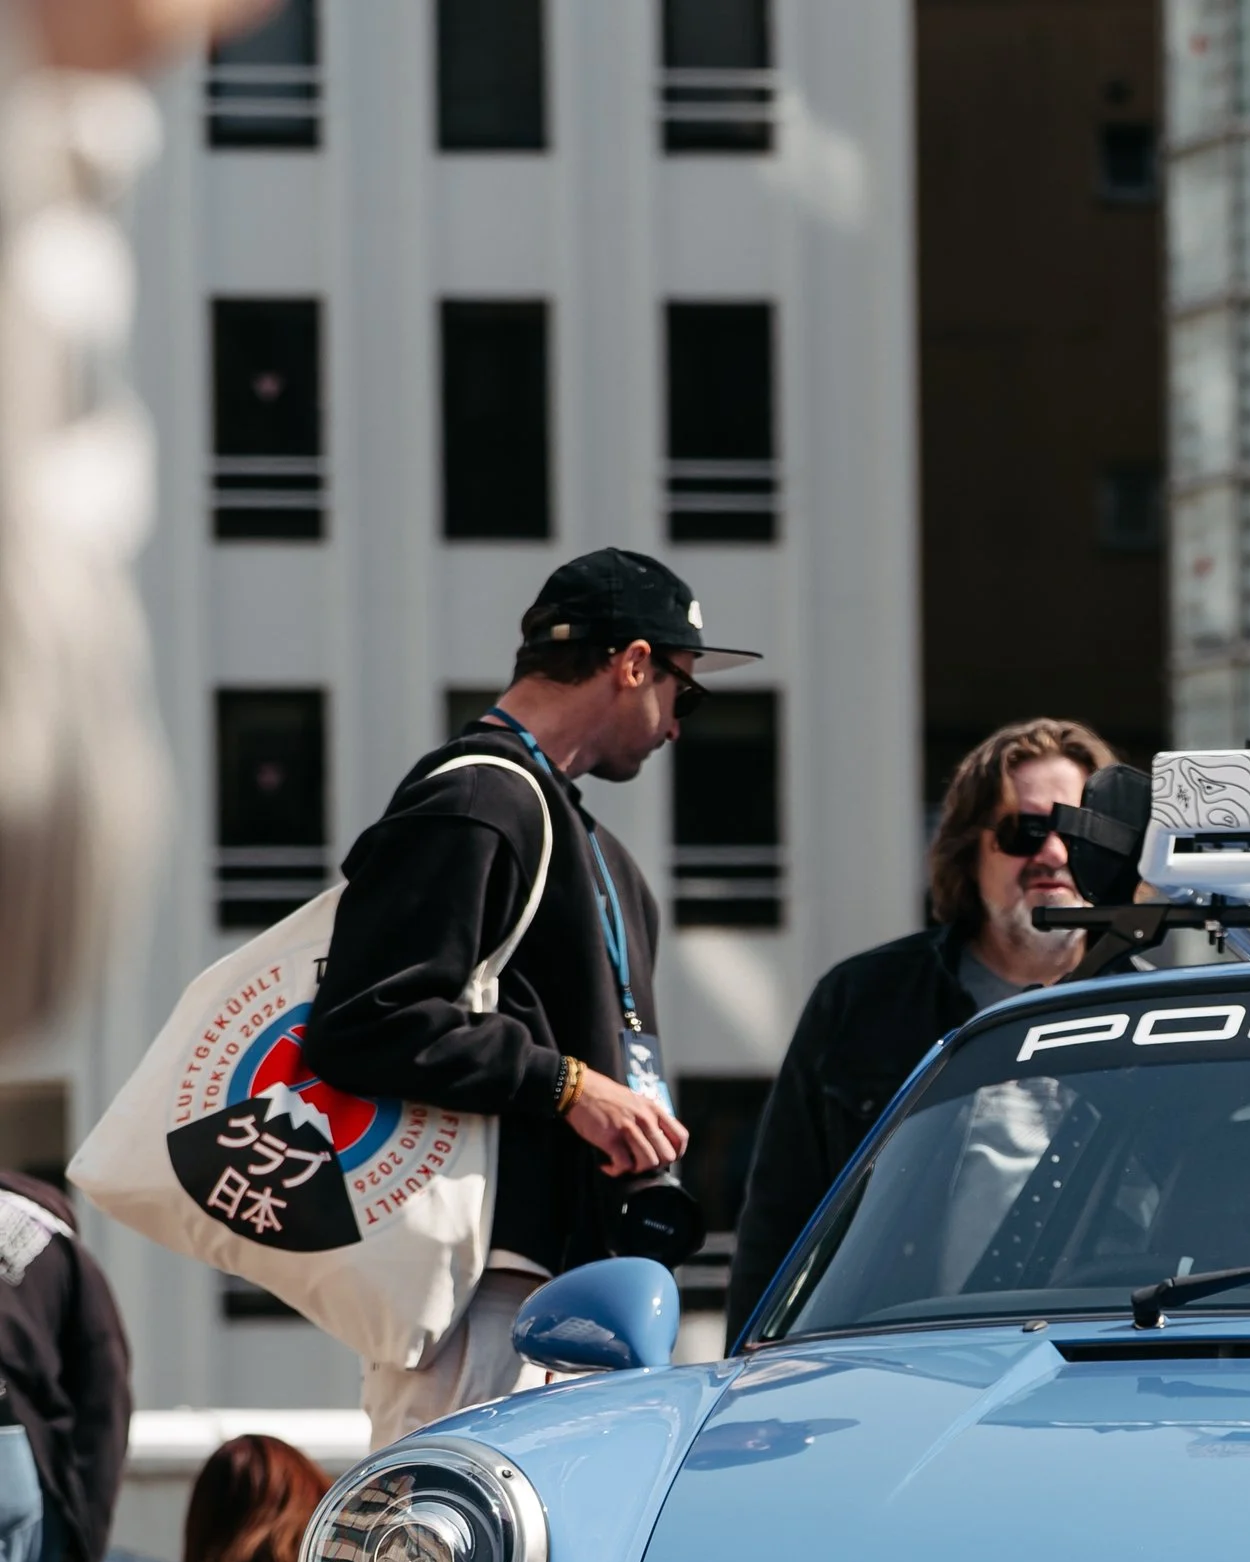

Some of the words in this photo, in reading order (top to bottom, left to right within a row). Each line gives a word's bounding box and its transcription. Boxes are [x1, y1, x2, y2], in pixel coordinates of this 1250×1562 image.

[176, 966, 283, 1124] LUFTGEKÜHLT
[204, 1042, 240, 1112] TOKYO
[239, 995, 287, 1040] 2026
[216, 1114, 332, 1189] クラブ
[353, 1151, 404, 1195] 2026
[206, 1166, 288, 1234] 日本
